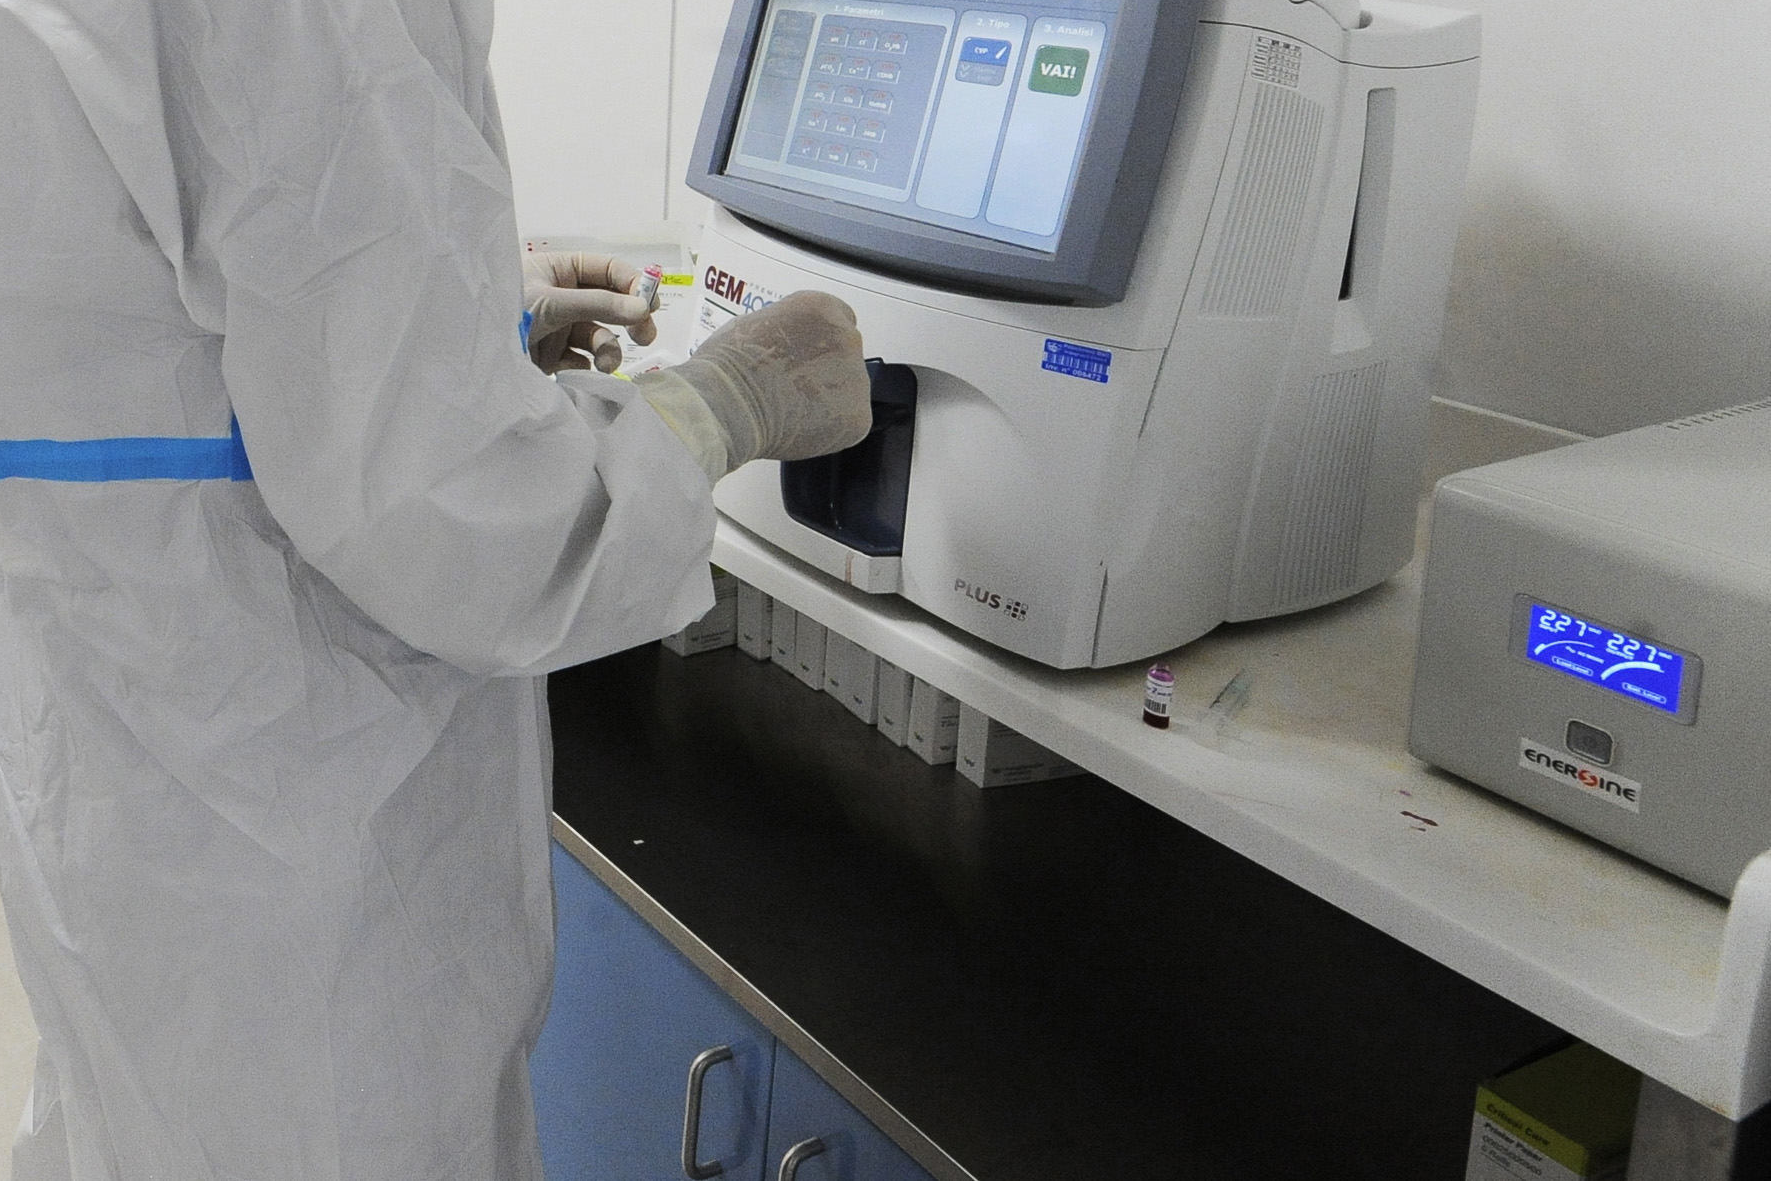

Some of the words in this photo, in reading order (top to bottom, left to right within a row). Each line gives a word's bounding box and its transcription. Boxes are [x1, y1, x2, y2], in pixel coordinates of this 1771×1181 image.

[844, 6, 884, 16] Parametri
[988, 19, 1010, 29] Tipo
[1044, 24, 1054, 33] 3.
[1057, 26, 1094, 37] Analisi
[1040, 62, 1077, 79] VAI!
[705, 265, 746, 305] GEM
[750, 282, 783, 299] PREMIE
[954, 578, 1002, 610] PLUS
[1540, 609, 1587, 637] 227
[1607, 633, 1657, 662] 227
[1484, 1122, 1516, 1145] Printer
[1516, 1141, 1543, 1162] Paper
[1525, 1127, 1551, 1146] Care
